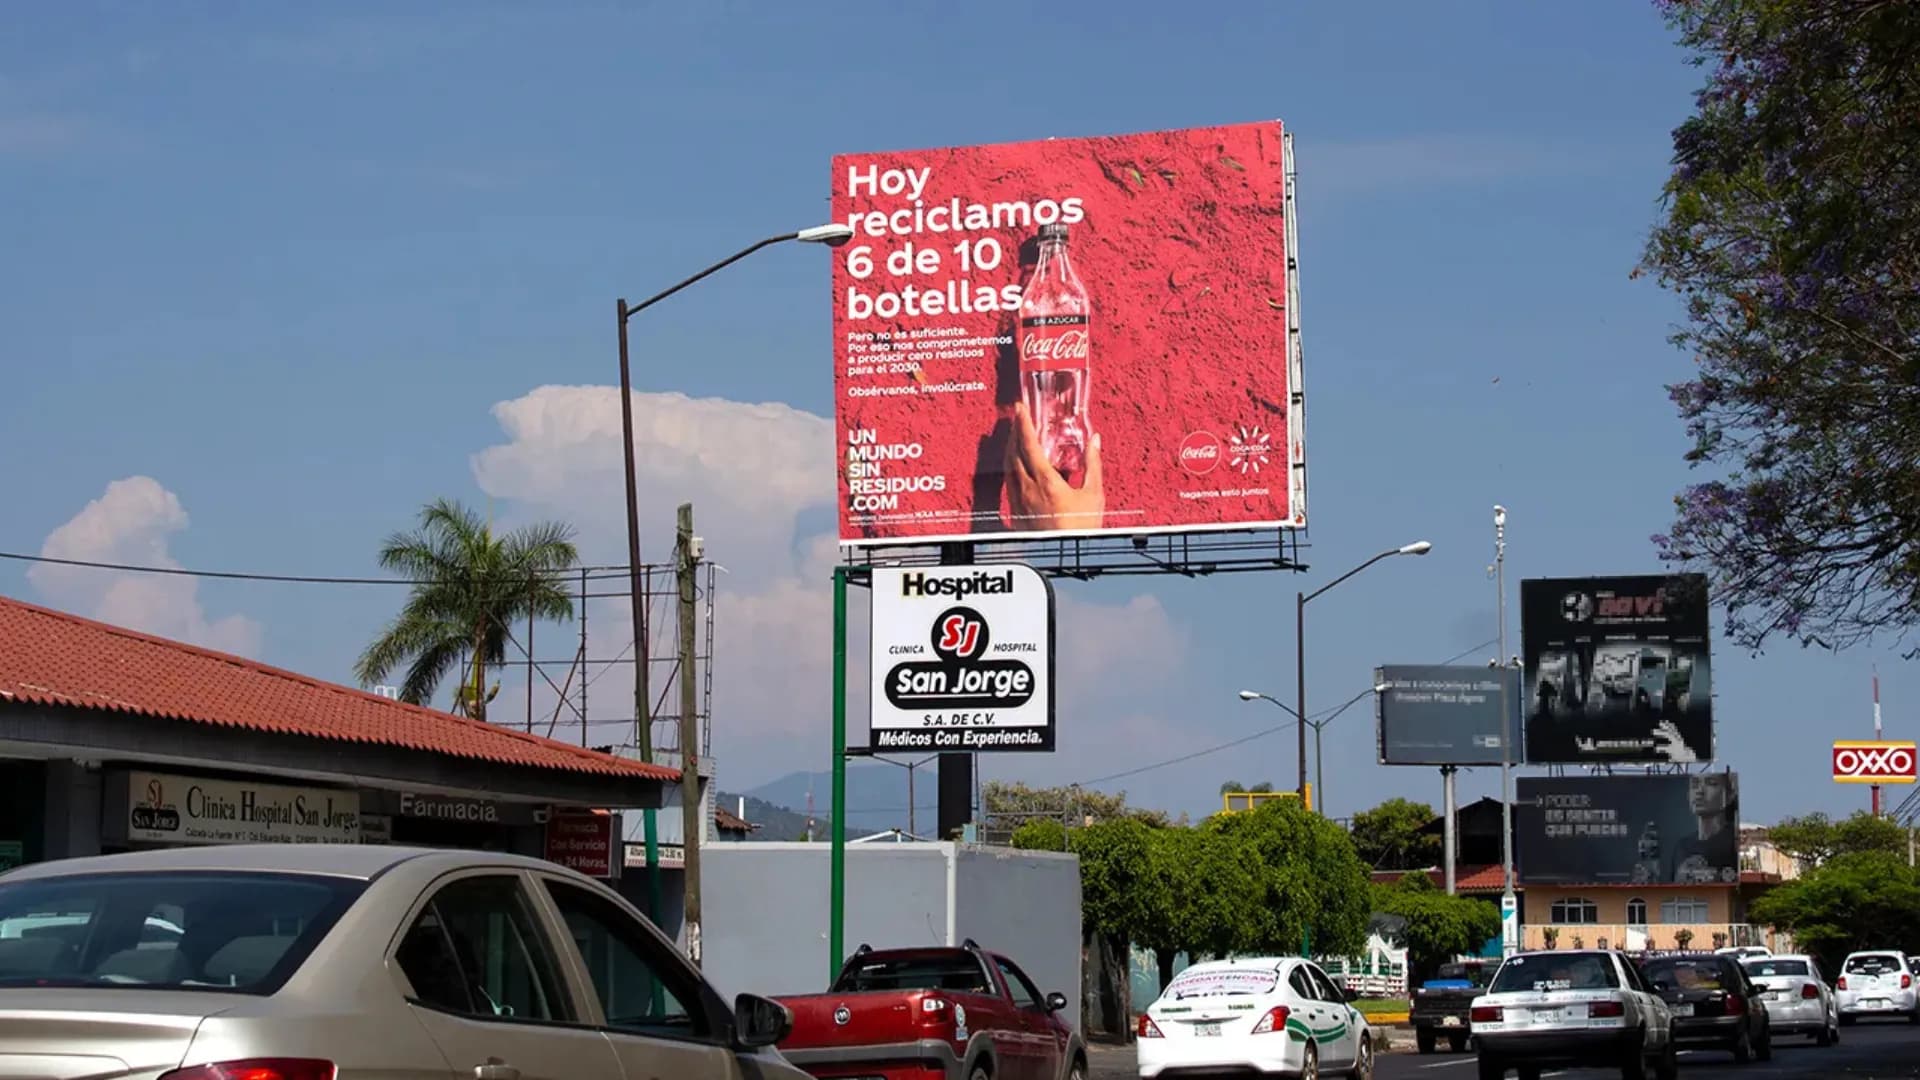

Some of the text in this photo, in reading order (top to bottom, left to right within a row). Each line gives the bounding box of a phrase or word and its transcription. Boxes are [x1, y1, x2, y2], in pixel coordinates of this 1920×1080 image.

[848, 165, 930, 200] Hoy
[848, 198, 1084, 237] reciclamos
[848, 237, 1002, 279] 6 de 10
[848, 280, 1033, 319] botellas.
[848, 327, 969, 342] Pero no es suficiente.
[848, 335, 1012, 352] Por eso nos comprometemos
[848, 349, 984, 364] a producir cero residuos
[848, 362, 922, 377] para el 2030.
[848, 381, 987, 398] Obsérvanos, involúcrate.
[849, 428, 876, 445] UN
[849, 443, 923, 461] MUNDO
[850, 462, 880, 477] SIN
[850, 475, 945, 494] RESIDUOS
[1180, 490, 1219, 499] hagamos
[1242, 488, 1269, 497] juntos
[850, 495, 898, 511] .COM
[903, 570, 1013, 601] Hospital
[940, 615, 980, 657] SJ
[889, 645, 924, 654] CLINICA
[993, 643, 1037, 652] HOSPITAL
[896, 668, 1029, 698] San Jorge
[923, 713, 996, 726] S.A. DE C.V.
[879, 729, 1043, 747] Médicos Con Experiencia.
[1836, 748, 1912, 775] OXXO
[240, 791, 292, 829] Hospital
[295, 795, 319, 826] San
[569, 838, 606, 850] Servicio
[566, 855, 577, 867] 24
